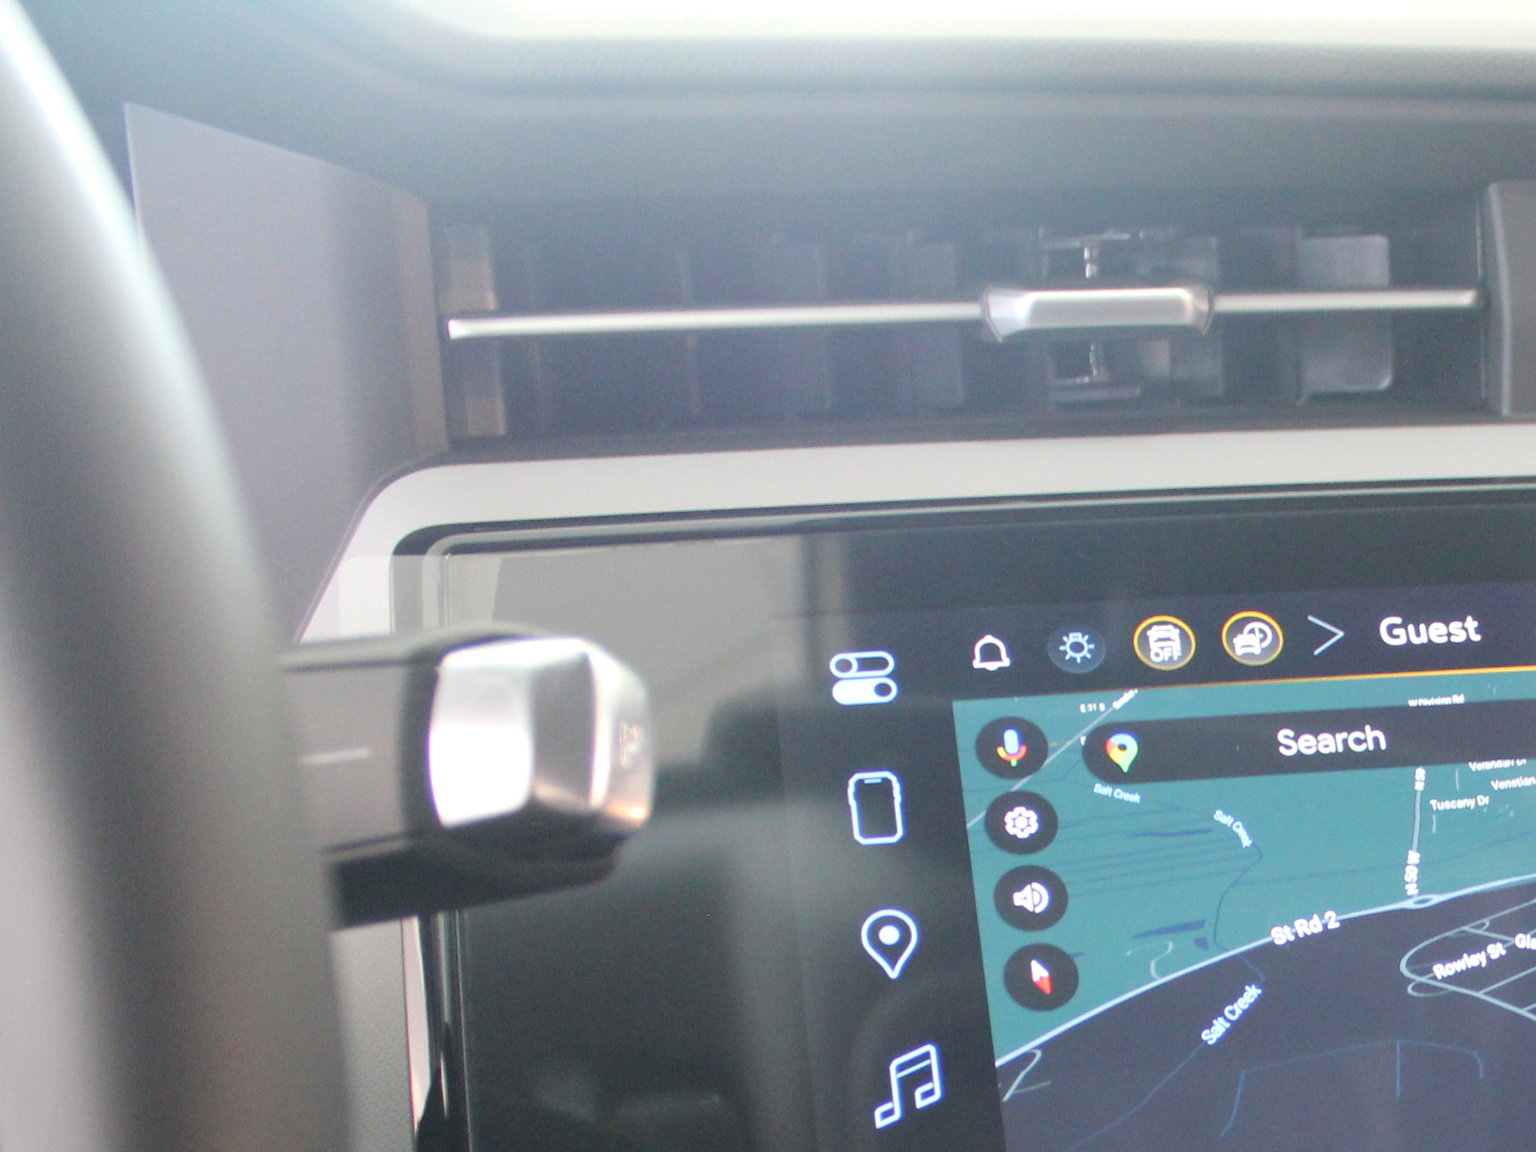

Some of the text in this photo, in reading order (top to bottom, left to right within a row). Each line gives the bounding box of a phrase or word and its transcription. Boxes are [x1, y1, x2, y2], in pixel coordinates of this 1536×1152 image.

[1379, 615, 1482, 646] Guest
[1150, 647, 1182, 662] OFF
[1277, 724, 1387, 756] Search
[1093, 782, 1141, 804] Salt Creek
[1490, 776, 1536, 790] Venetian
[1429, 795, 1490, 811] Tuscany Dr
[1213, 809, 1253, 849] Salt Creek
[1270, 910, 1340, 946] St Rd 2
[1432, 941, 1507, 981] Rowley St
[1201, 983, 1262, 1045] Salt Creek
